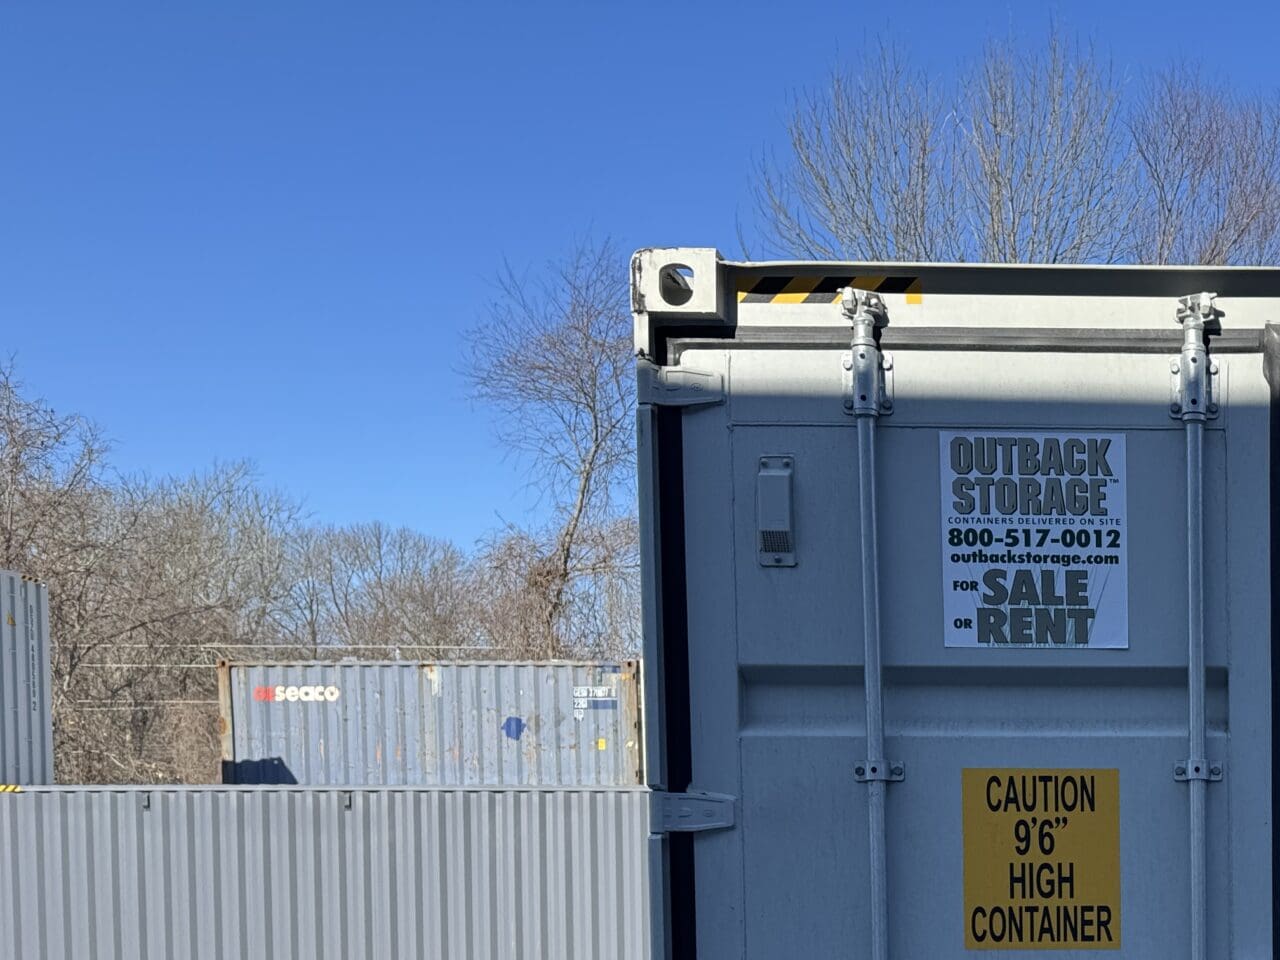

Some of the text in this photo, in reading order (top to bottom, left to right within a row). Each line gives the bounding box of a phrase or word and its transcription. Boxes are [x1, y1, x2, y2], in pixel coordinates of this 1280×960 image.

[949, 436, 1114, 477] OUTBACK
[951, 477, 1108, 516] STORAGE
[948, 517, 1014, 525] CONTAINERS
[1018, 517, 1075, 525] DELIVERED
[1099, 518, 1121, 526] SITE
[948, 528, 1121, 548] 800-517-0012
[950, 549, 1120, 567] outbackstorage.com
[952, 568, 1089, 606] FOR SALE
[953, 607, 1095, 644] OR RENT
[986, 775, 1096, 813] CAUTION
[1009, 862, 1074, 899] HIGH
[971, 905, 1113, 943] CONTAINER
